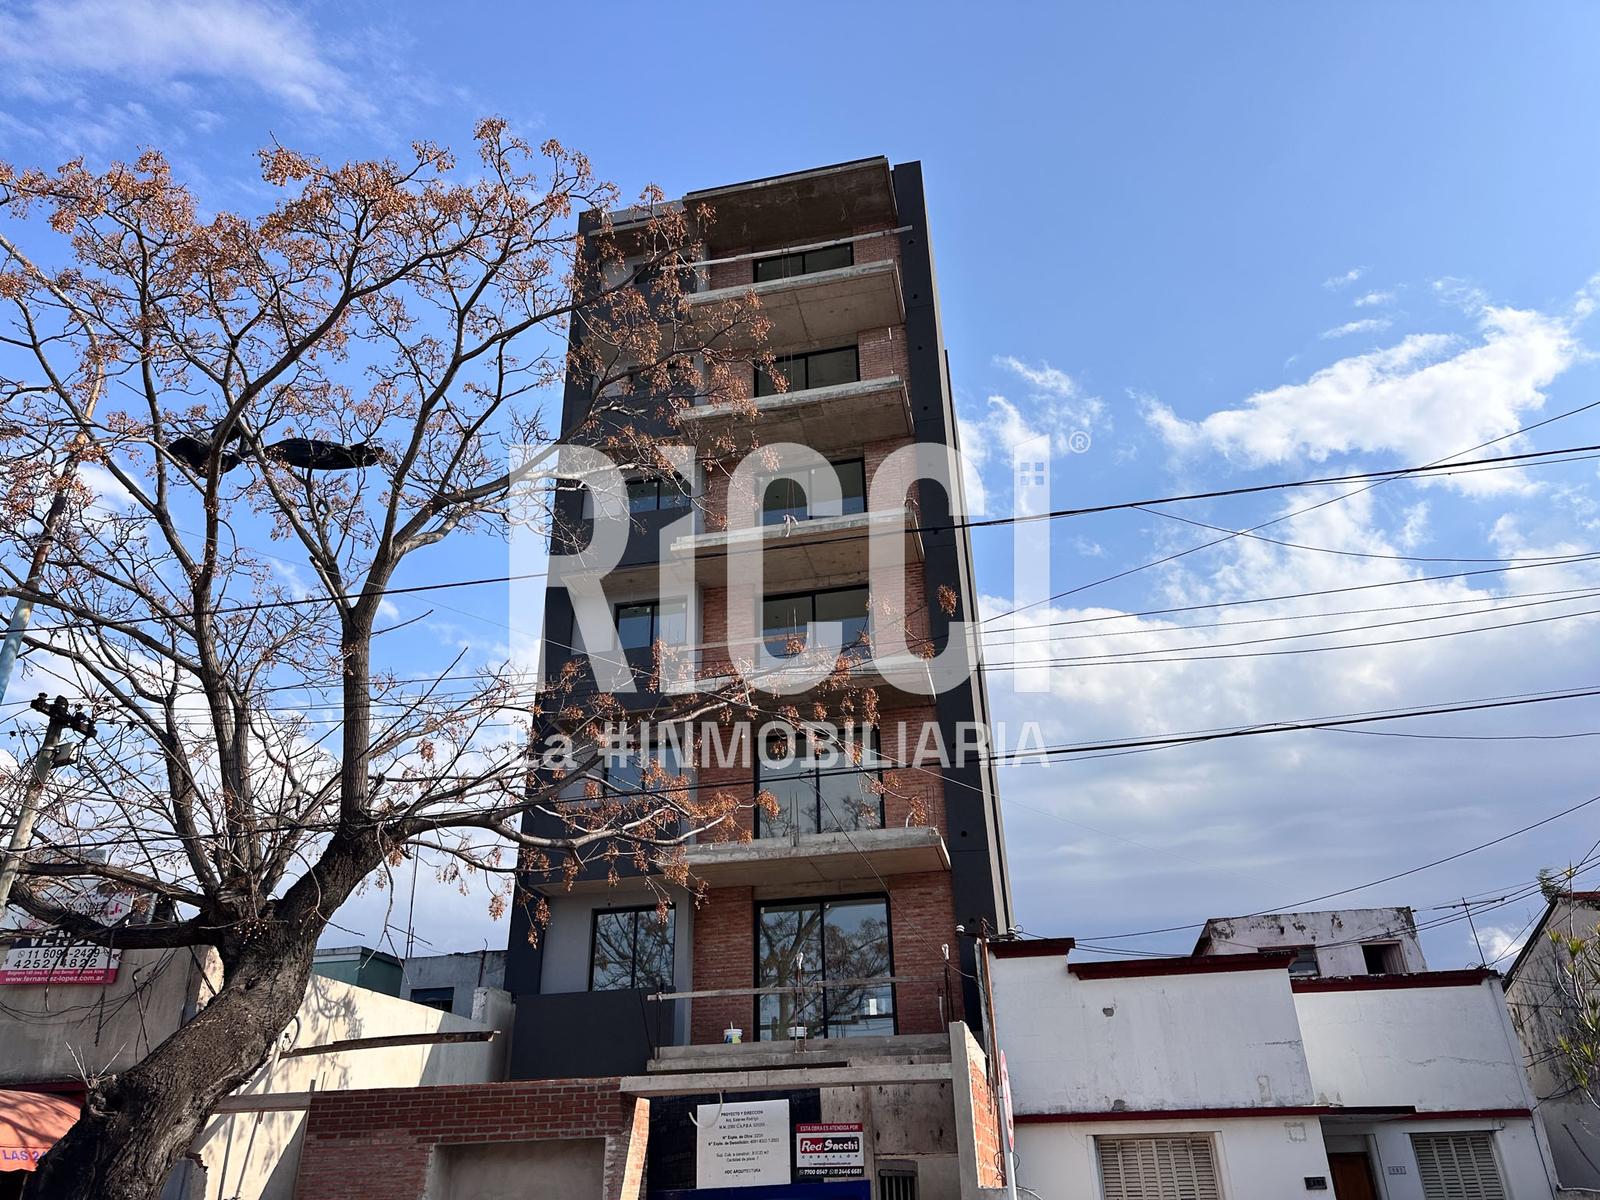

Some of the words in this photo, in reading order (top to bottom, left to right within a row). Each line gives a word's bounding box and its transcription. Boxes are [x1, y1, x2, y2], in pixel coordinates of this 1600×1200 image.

[28, 950, 39, 959] 11
[43, 948, 100, 959] 609-2429
[801, 1140, 823, 1152] Red
[824, 1139, 858, 1151] Sacchi
[3, 1150, 28, 1160] LAS
